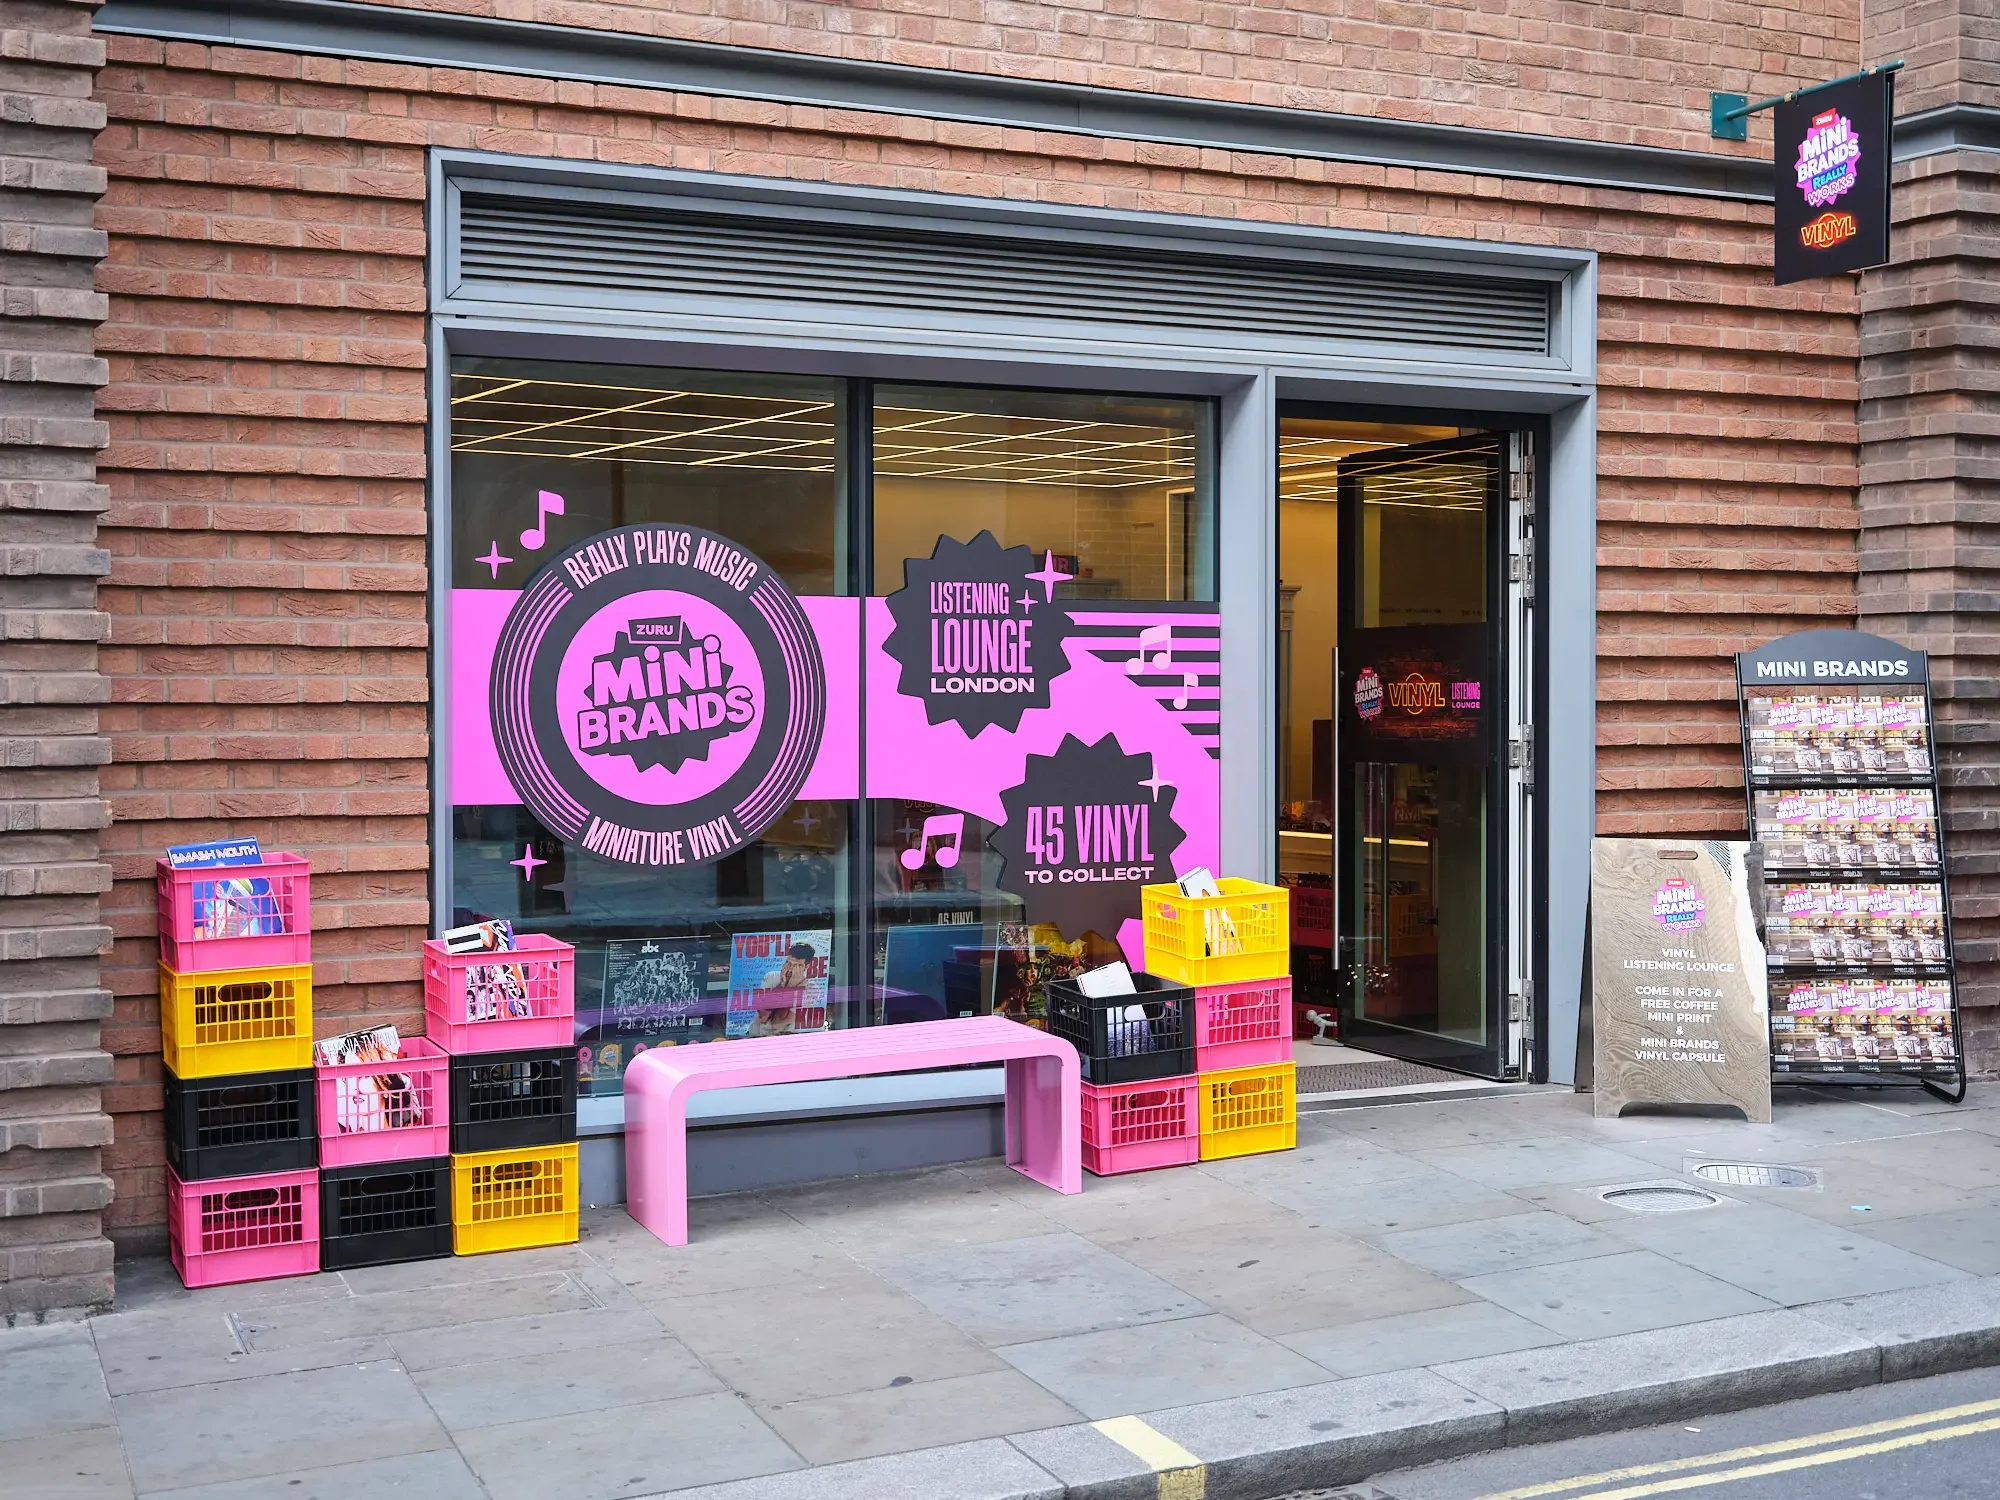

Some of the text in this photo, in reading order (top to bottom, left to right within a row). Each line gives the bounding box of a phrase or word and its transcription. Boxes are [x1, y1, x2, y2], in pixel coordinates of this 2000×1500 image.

[1797, 138, 1859, 182] BRANDS
[1813, 163, 1847, 190] REALLY
[1808, 173, 1855, 206] WORKS
[1801, 215, 1856, 246] VINYL
[563, 530, 758, 592] REALLY PLAYS MUSIC
[930, 582, 1010, 614] LISTENING
[636, 624, 674, 636] ZURU
[932, 618, 1032, 674] LOUNGE
[1756, 660, 1909, 677] MINI BRANDS
[930, 677, 1035, 694] LONDON
[1388, 682, 1446, 706] VINYL
[1452, 682, 1480, 700] LISTENING
[1354, 687, 1384, 704] BRANDS
[580, 686, 755, 749] BRANDS
[1776, 806, 1816, 820] BRANDS
[582, 815, 742, 866] MINIATURE VINYL
[1026, 804, 1154, 865] 45 VINYL
[172, 845, 258, 864] SMASH MOUTH
[1024, 866, 1154, 884] TO COLLECT
[1652, 900, 1705, 916] BRANDS
[1782, 900, 1820, 914] BRANDS
[1666, 912, 1695, 922] REALLY
[641, 940, 660, 953] abc
[734, 934, 792, 958] YOU'LL
[1662, 948, 1696, 958] VINYL
[805, 956, 828, 978] BE
[1624, 960, 1735, 972] LISTENING LOUNGE
[1635, 986, 1724, 998] COME IN FOR A
[1640, 998, 1718, 1010] FREE COFFEE
[1786, 998, 1824, 1012] BRANDS
[794, 1006, 824, 1030] KID
[1648, 1012, 1712, 1023] MINI PRINT
[1676, 1026, 1684, 1036] &
[322, 1030, 398, 1060] SHANIA TWAIN
[1640, 1038, 1720, 1050] MINI BRANDS
[1634, 1050, 1726, 1062] VINYL CAPSULE
